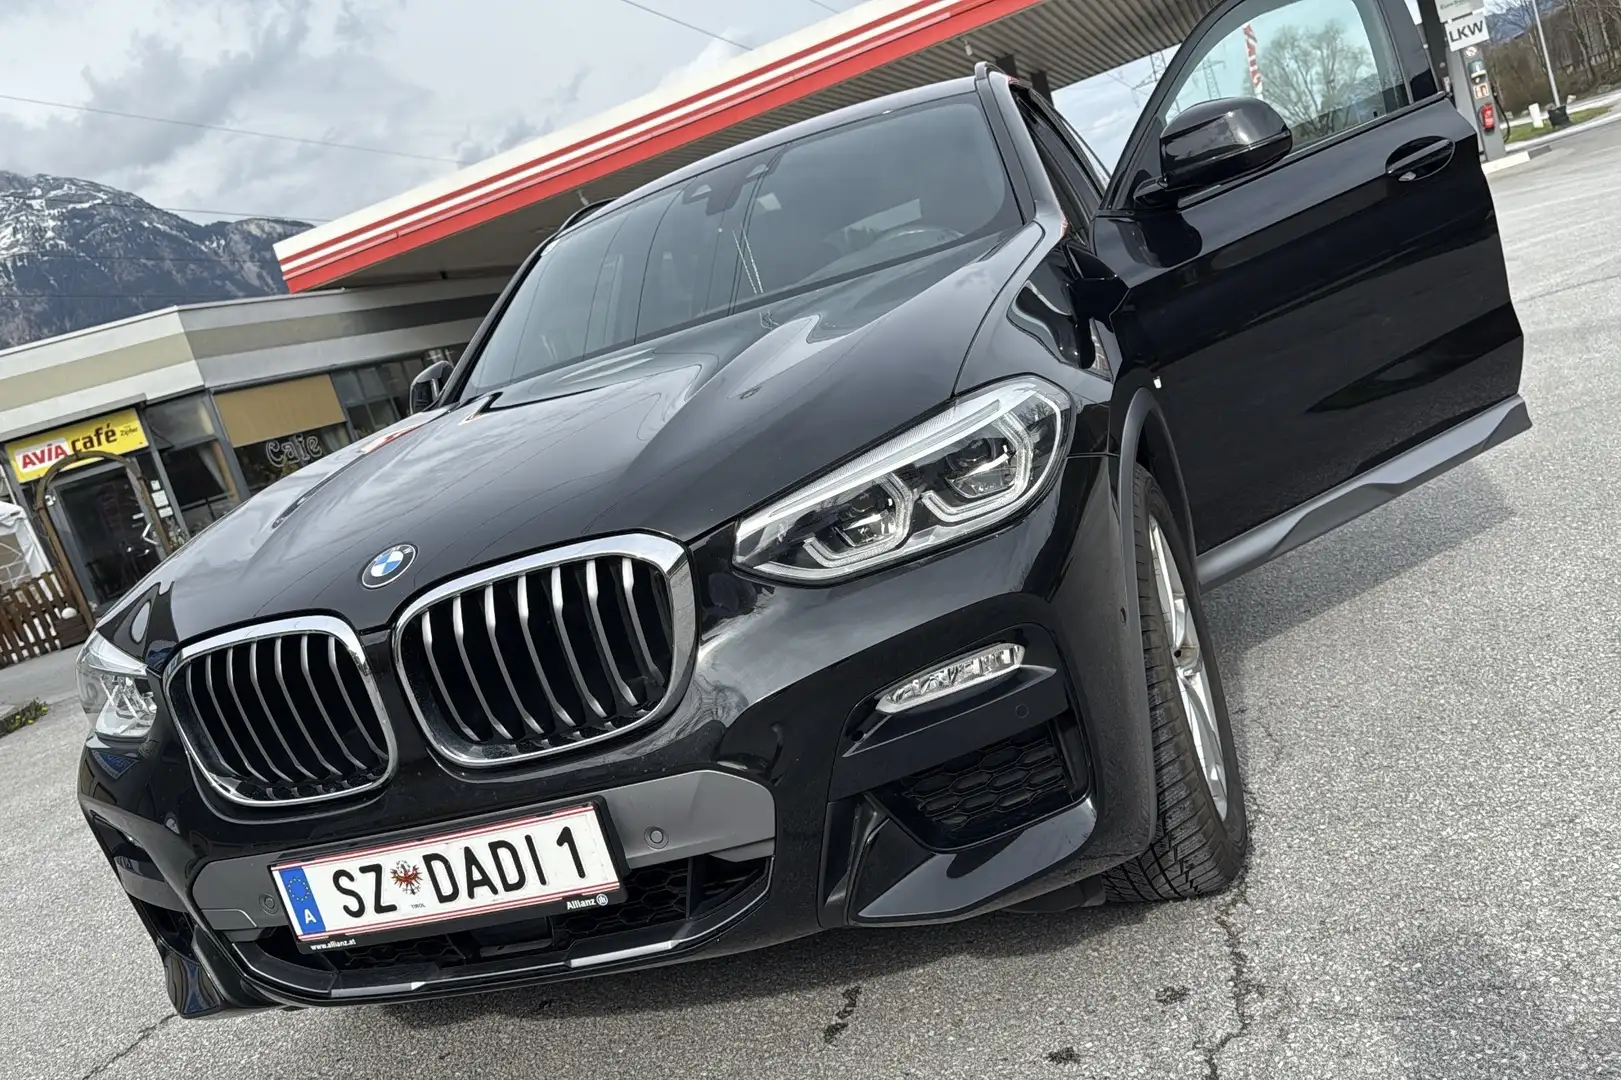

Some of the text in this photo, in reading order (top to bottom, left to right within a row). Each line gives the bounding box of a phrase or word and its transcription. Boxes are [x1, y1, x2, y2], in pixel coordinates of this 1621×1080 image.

[1449, 20, 1483, 42] LKW
[71, 423, 117, 452] café
[332, 826, 586, 918] SZ DADI 1
[566, 898, 597, 910] Allianz
[304, 909, 318, 925] A
[310, 938, 357, 950] www.allianz.at
